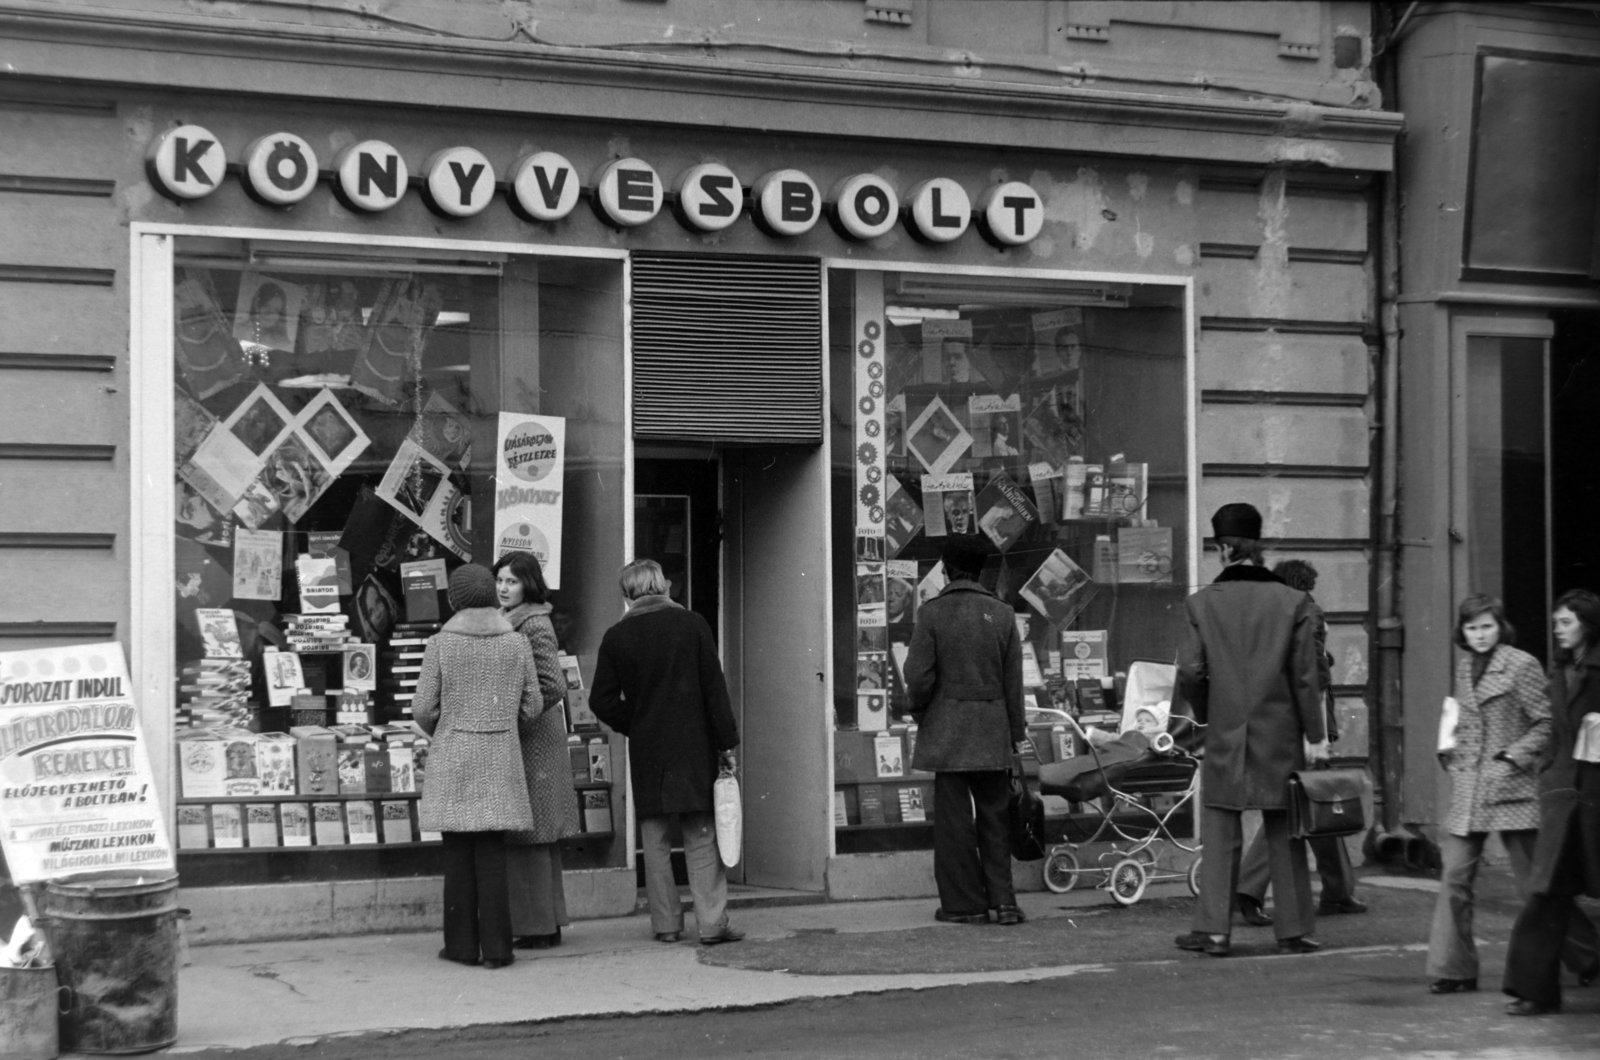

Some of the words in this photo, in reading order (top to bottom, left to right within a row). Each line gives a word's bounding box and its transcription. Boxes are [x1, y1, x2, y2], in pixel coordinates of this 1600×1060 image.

[173, 137, 1035, 236] KÖNYVESBOLT
[507, 449, 556, 469] RÉSZLETRE
[497, 486, 561, 509] KÖNYVET
[501, 537, 533, 547] NYISSON
[0, 680, 73, 705] SOROZAT
[77, 676, 126, 699] INDUL
[0, 703, 136, 758] LÁGIRODALOM
[35, 746, 133, 778] REMEKEI
[4, 776, 128, 799] ELŐJEGYEZHETŐ
[63, 797, 72, 808] A
[56, 820, 109, 836] ÉLETRAJZI
[109, 819, 155, 834] LEXIKON
[49, 837, 100, 853] MŰSZAKI
[101, 833, 156, 848] LEXIKON
[42, 851, 130, 870] VILÁGIRODALMI
[130, 848, 169, 863] LEXIKON
